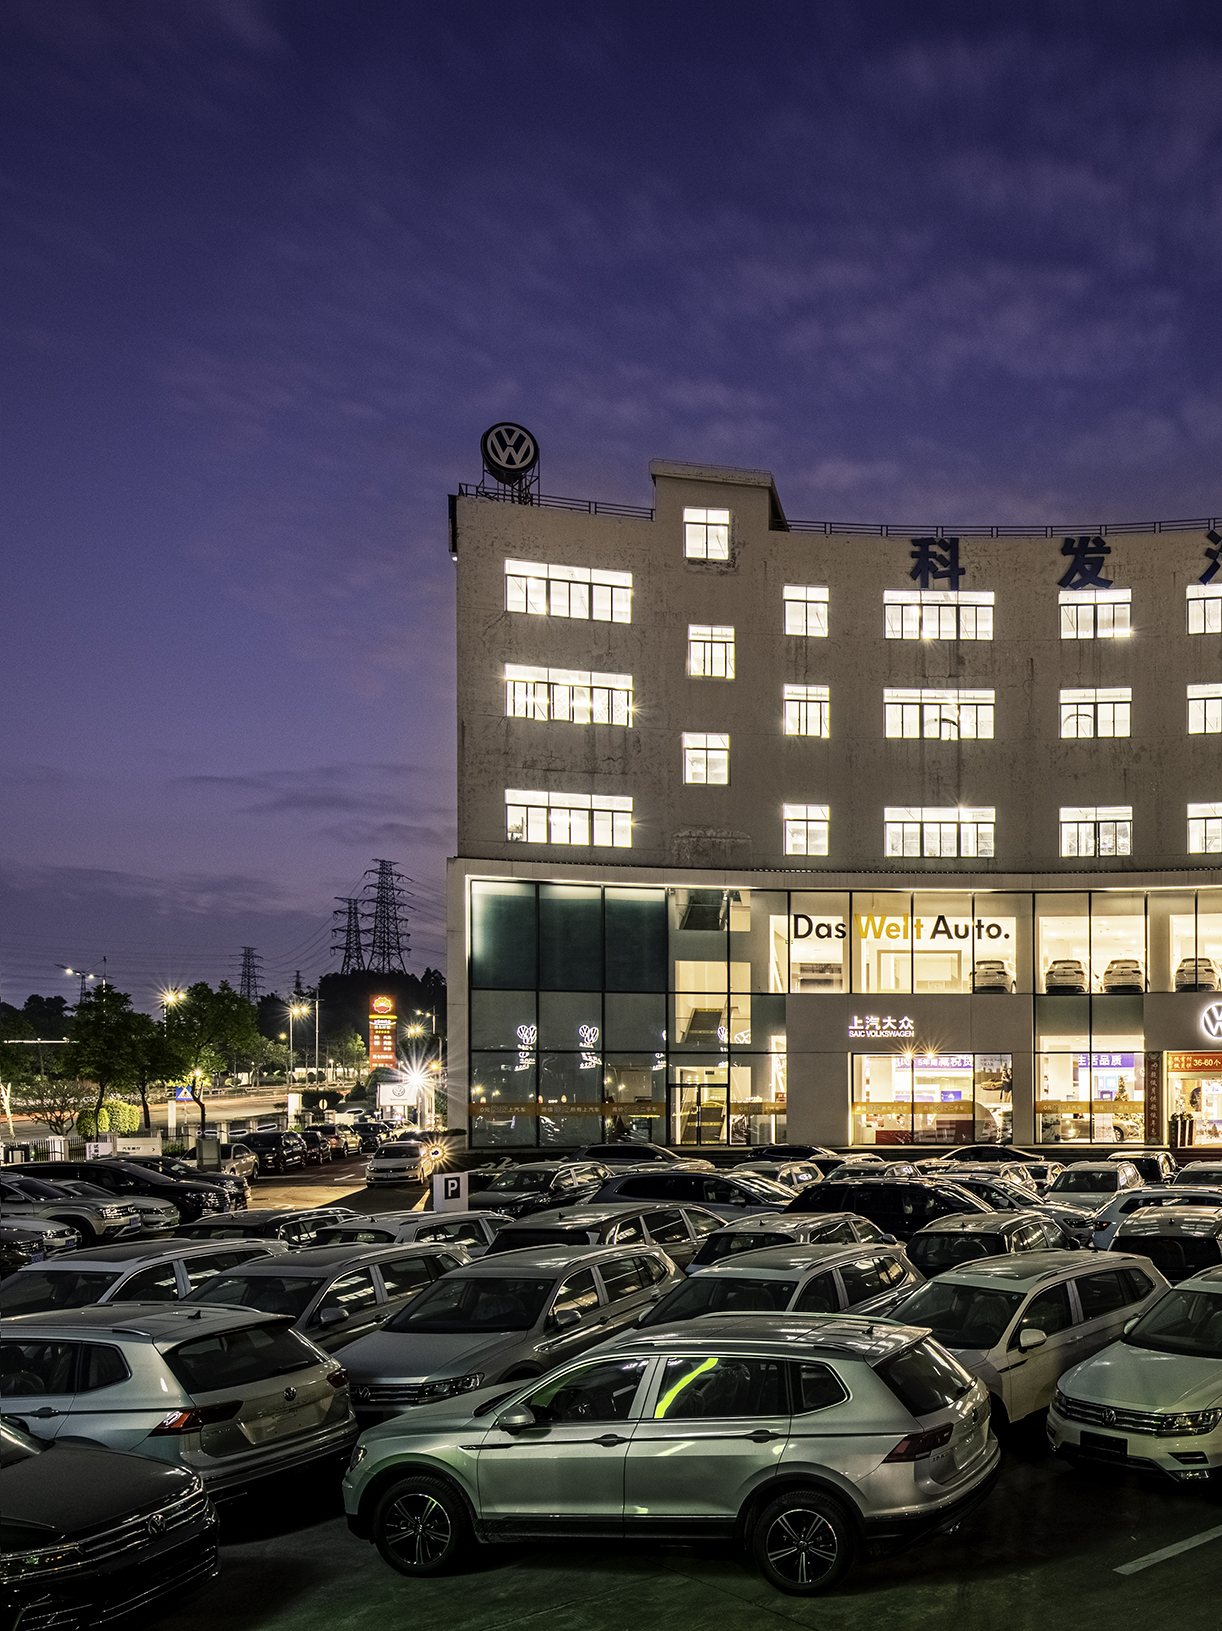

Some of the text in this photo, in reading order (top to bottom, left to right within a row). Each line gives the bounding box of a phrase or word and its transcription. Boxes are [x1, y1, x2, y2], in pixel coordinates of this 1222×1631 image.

[487, 425, 534, 469] VW
[793, 914, 847, 940] Das
[848, 1015, 915, 1030] 上汽大众
[848, 1030, 915, 1038] SAIC VOLKSWAGEN
[447, 1179, 459, 1197] P
